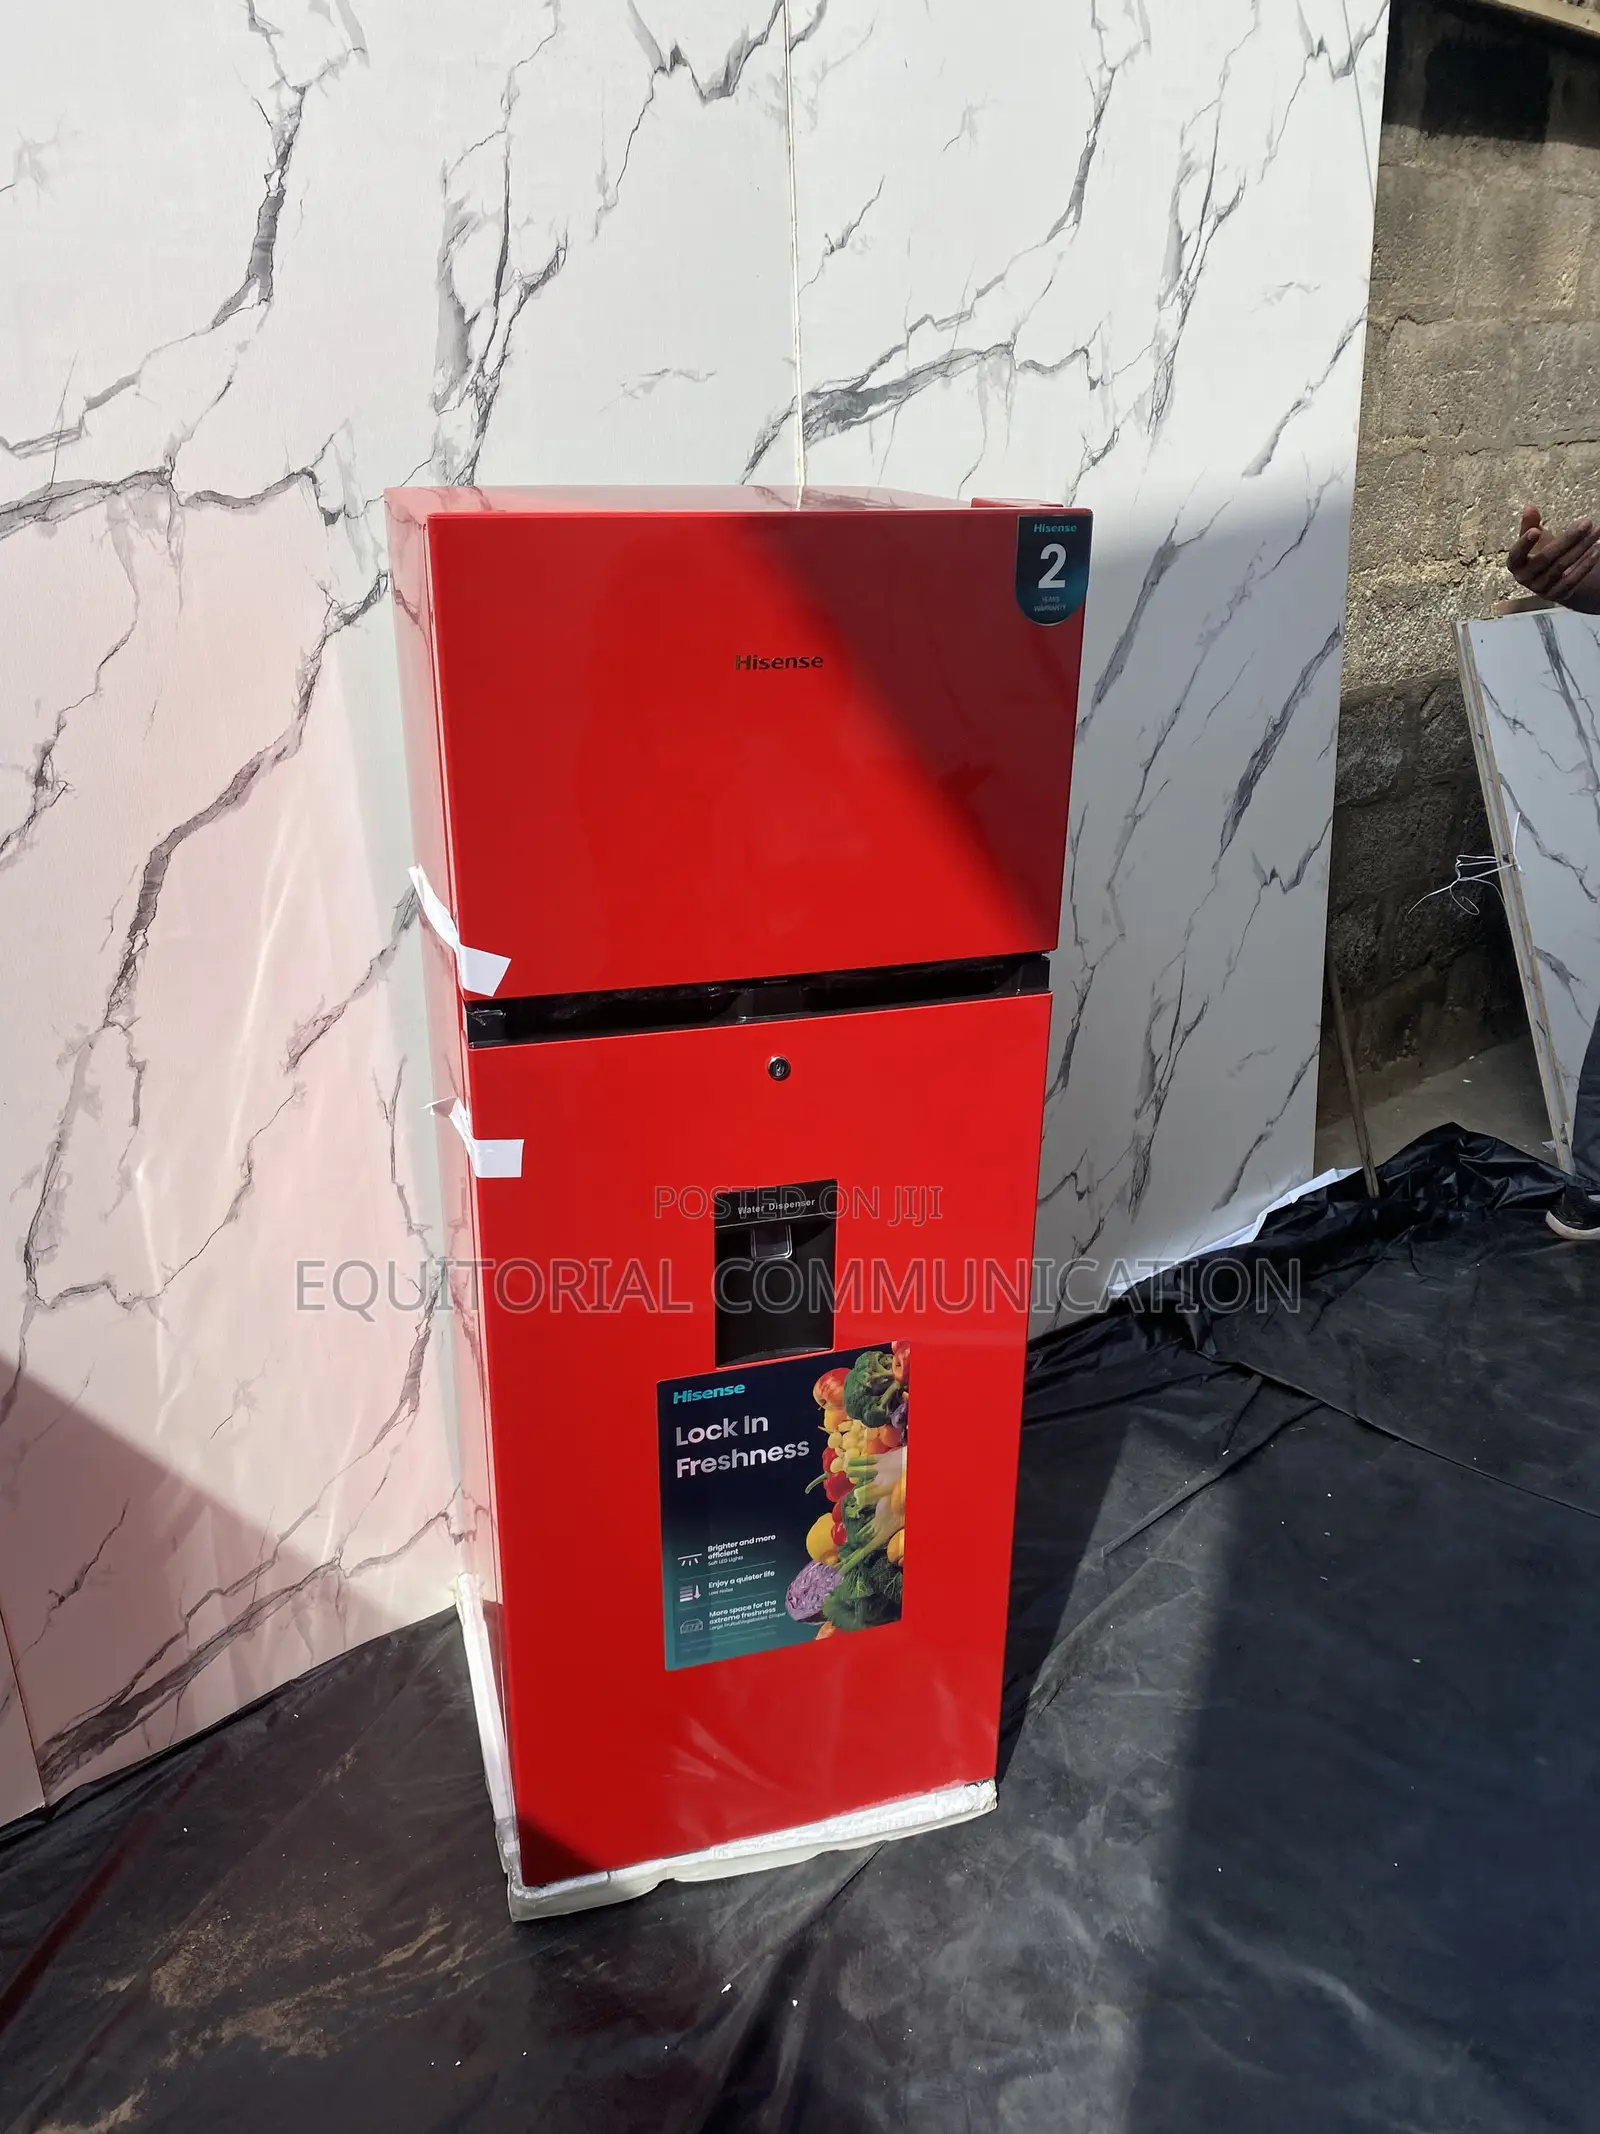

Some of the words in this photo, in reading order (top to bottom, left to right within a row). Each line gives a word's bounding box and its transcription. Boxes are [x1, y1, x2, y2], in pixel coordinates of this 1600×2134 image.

[1033, 523, 1078, 533] Hisense
[1038, 543, 1067, 589] 2
[735, 654, 824, 671] Hisense
[737, 1203, 765, 1216] Water
[768, 1197, 816, 1213] Dispenser
[673, 1383, 746, 1405] Hisense
[675, 1417, 739, 1447] Lock
[743, 1415, 769, 1435] In
[676, 1440, 810, 1479] Freshness
[707, 1541, 738, 1553] Brighter
[739, 1537, 755, 1546] and
[755, 1534, 776, 1543] more
[707, 1548, 739, 1560] efficient
[708, 1580, 729, 1589] Enjoy
[735, 1572, 763, 1585] quieter
[763, 1570, 776, 1578] life
[709, 1609, 729, 1618] More
[729, 1605, 752, 1616] space
[752, 1602, 764, 1610] for
[764, 1600, 777, 1608] the
[709, 1614, 741, 1625] extreme
[741, 1607, 777, 1619] freshness
